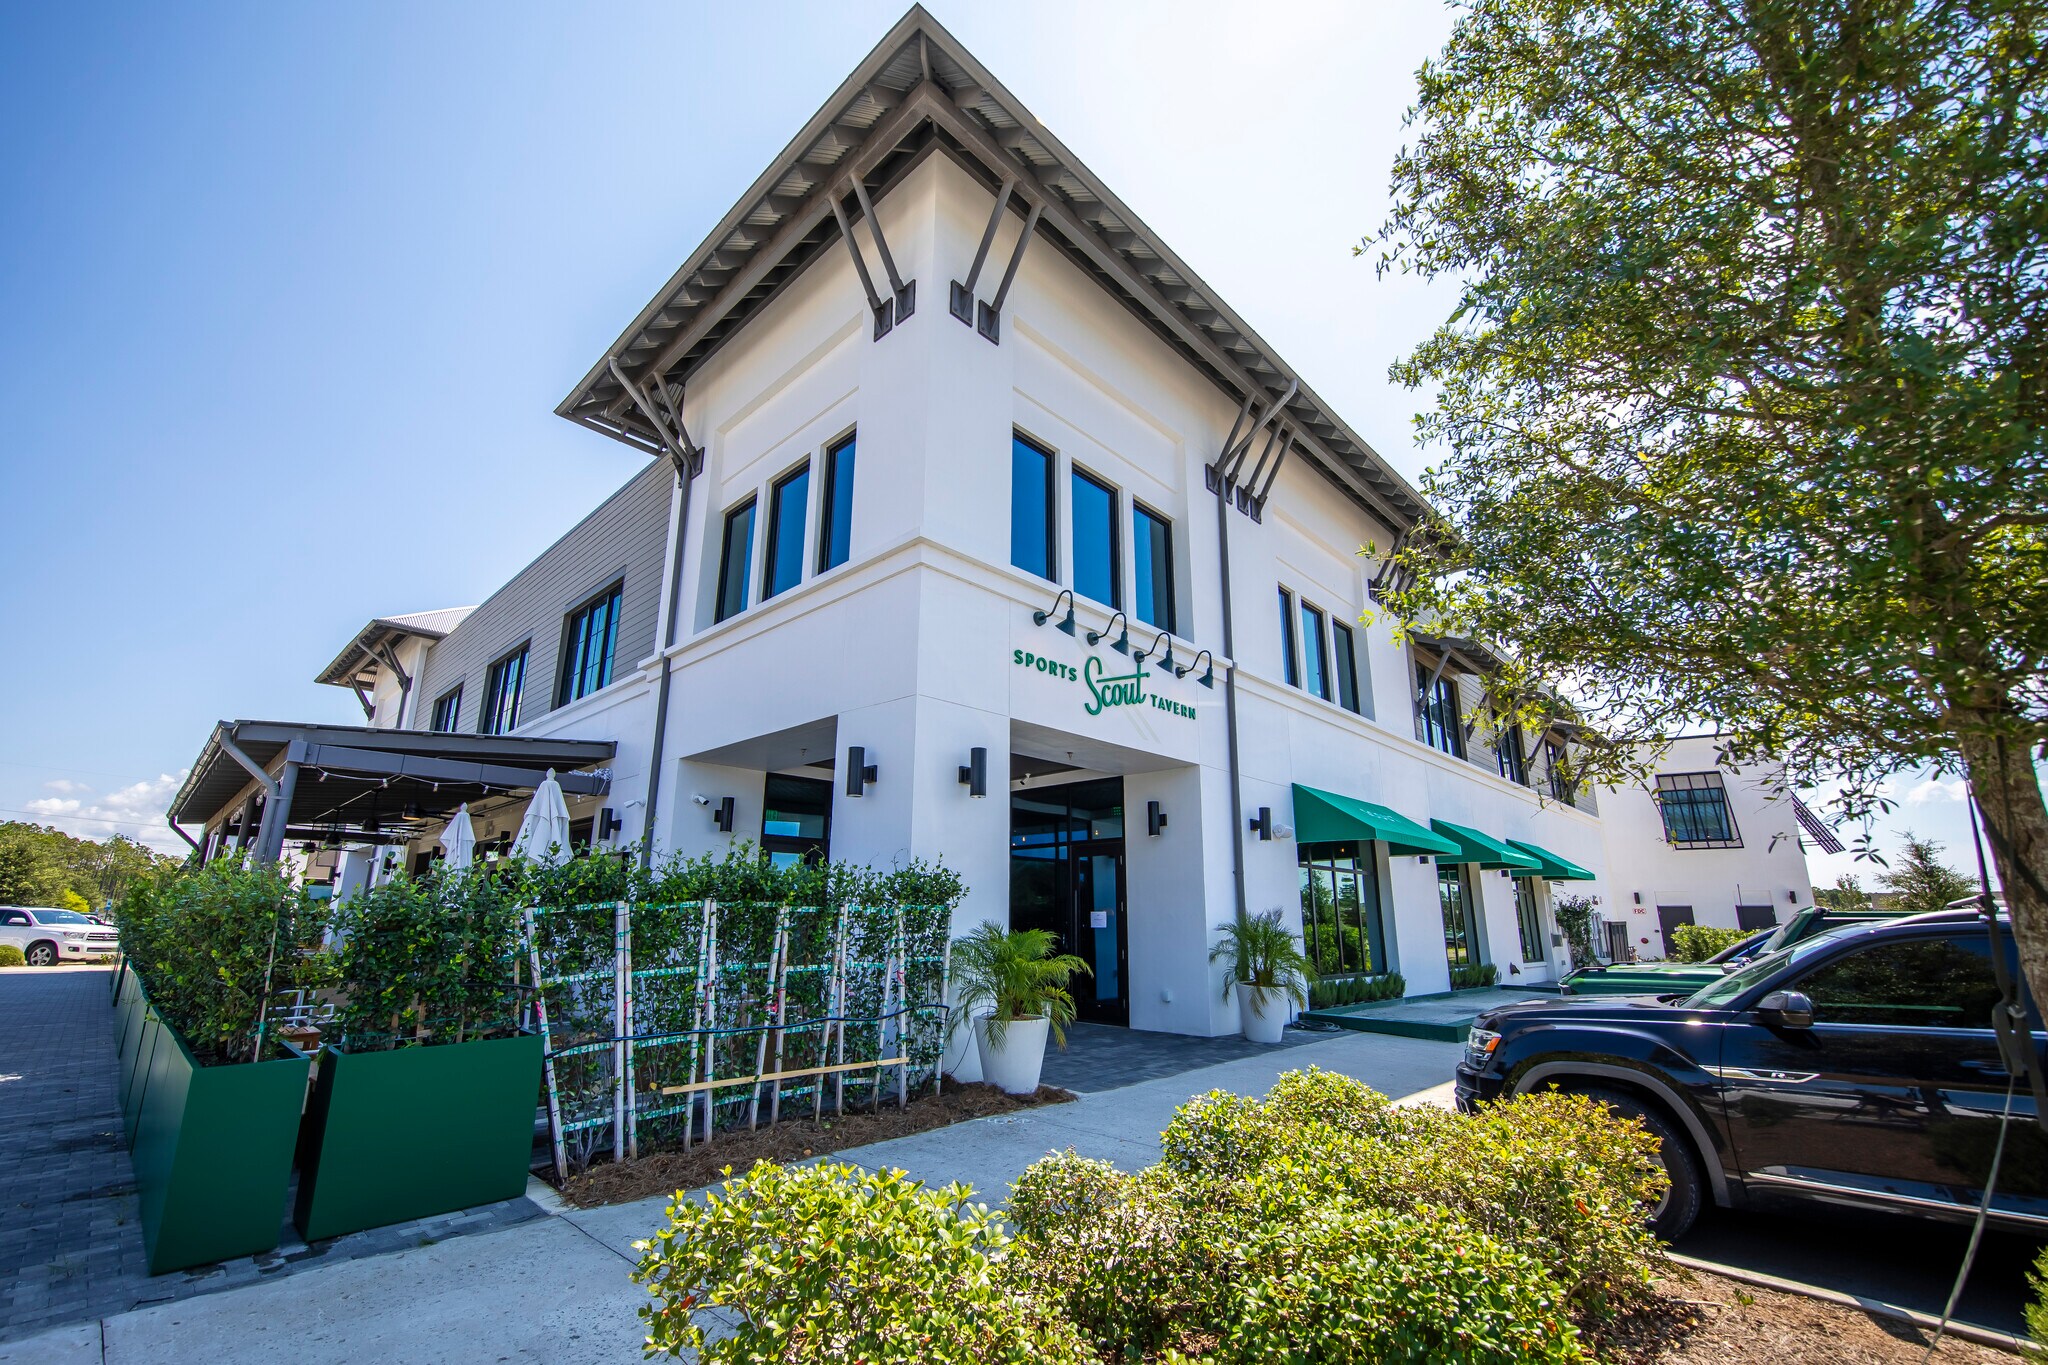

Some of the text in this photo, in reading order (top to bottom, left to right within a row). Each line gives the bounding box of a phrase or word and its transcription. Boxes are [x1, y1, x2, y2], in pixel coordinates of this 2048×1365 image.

[1014, 649, 1196, 720] SPORTS Scout TAVERN
